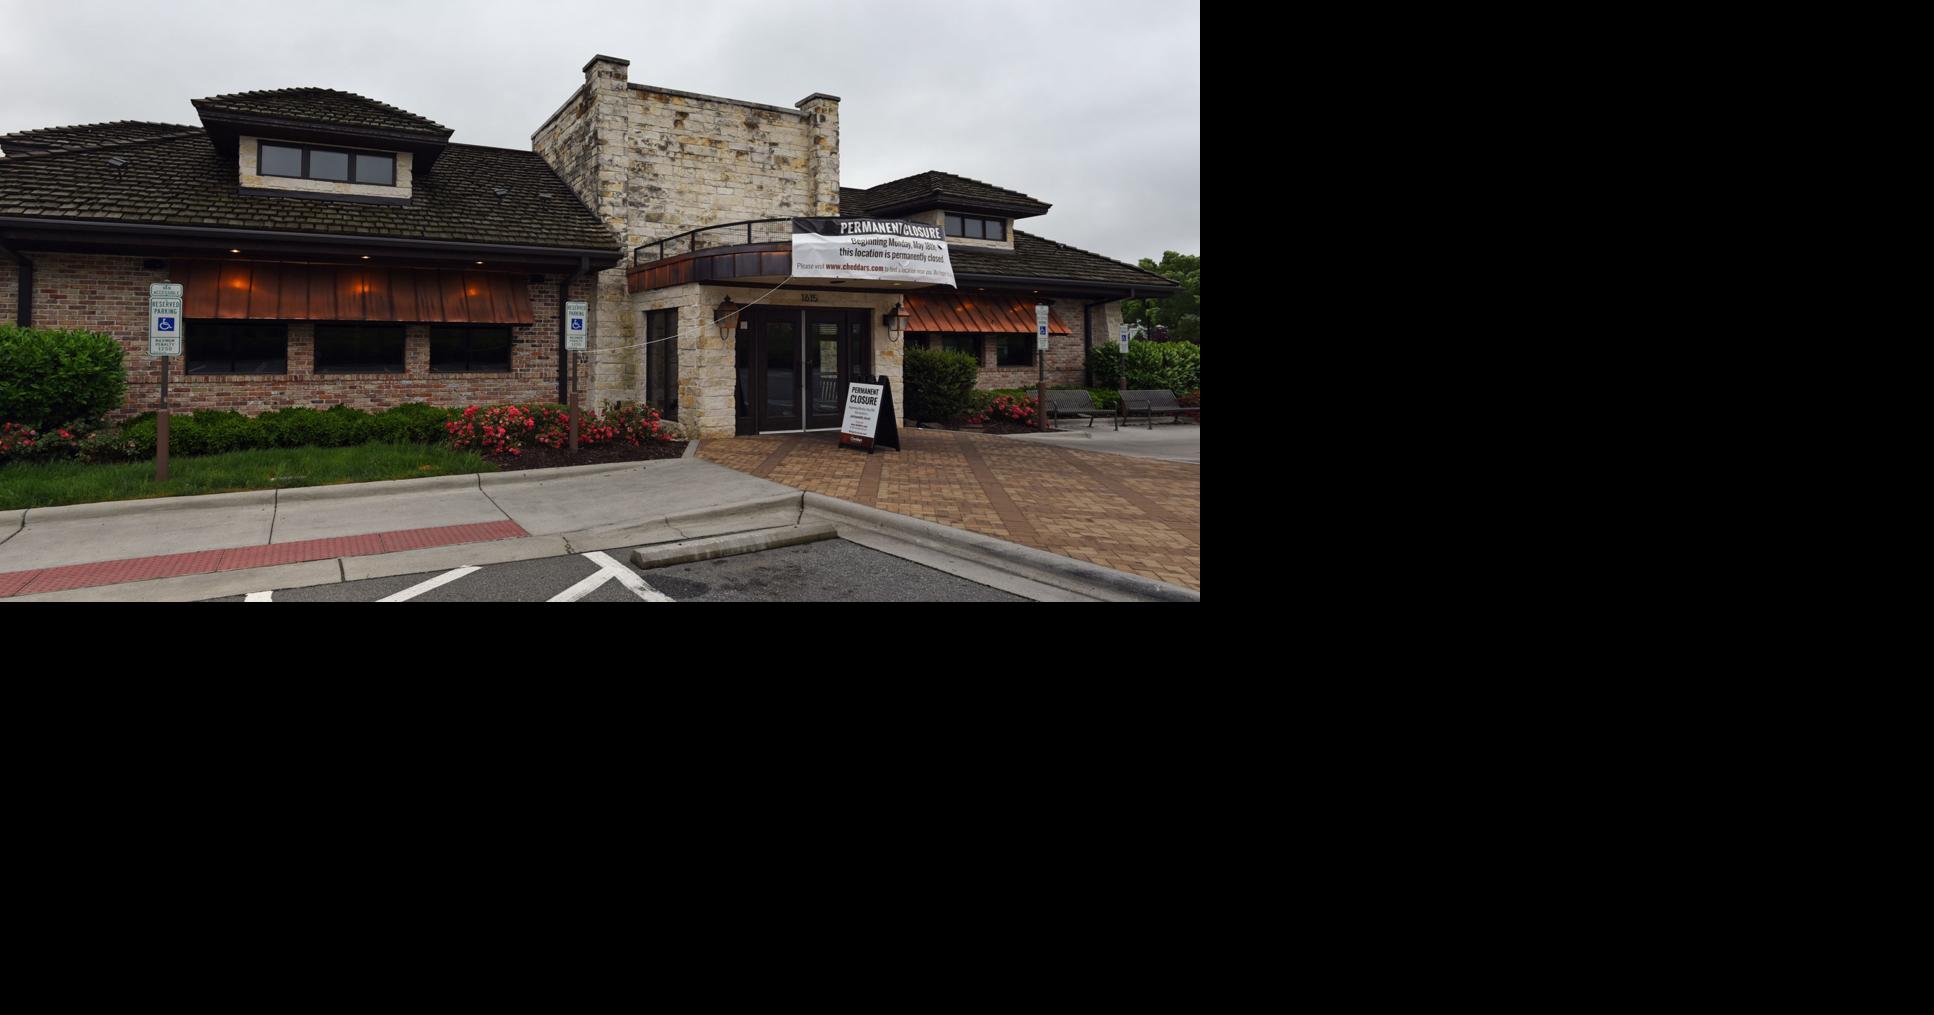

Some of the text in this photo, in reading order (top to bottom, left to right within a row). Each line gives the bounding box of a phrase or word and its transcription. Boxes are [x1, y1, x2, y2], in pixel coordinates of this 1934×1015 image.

[840, 221, 942, 239] PERMANENT CLOSURE
[851, 238, 887, 248] Beginning
[913, 241, 924, 251] May
[840, 248, 854, 257] this
[855, 248, 883, 258] location
[884, 250, 891, 259] is
[891, 251, 927, 263] permanently
[825, 263, 884, 272] www.cheddars.com
[851, 386, 879, 395] PERMANENT
[850, 395, 877, 406] CLOSURE
